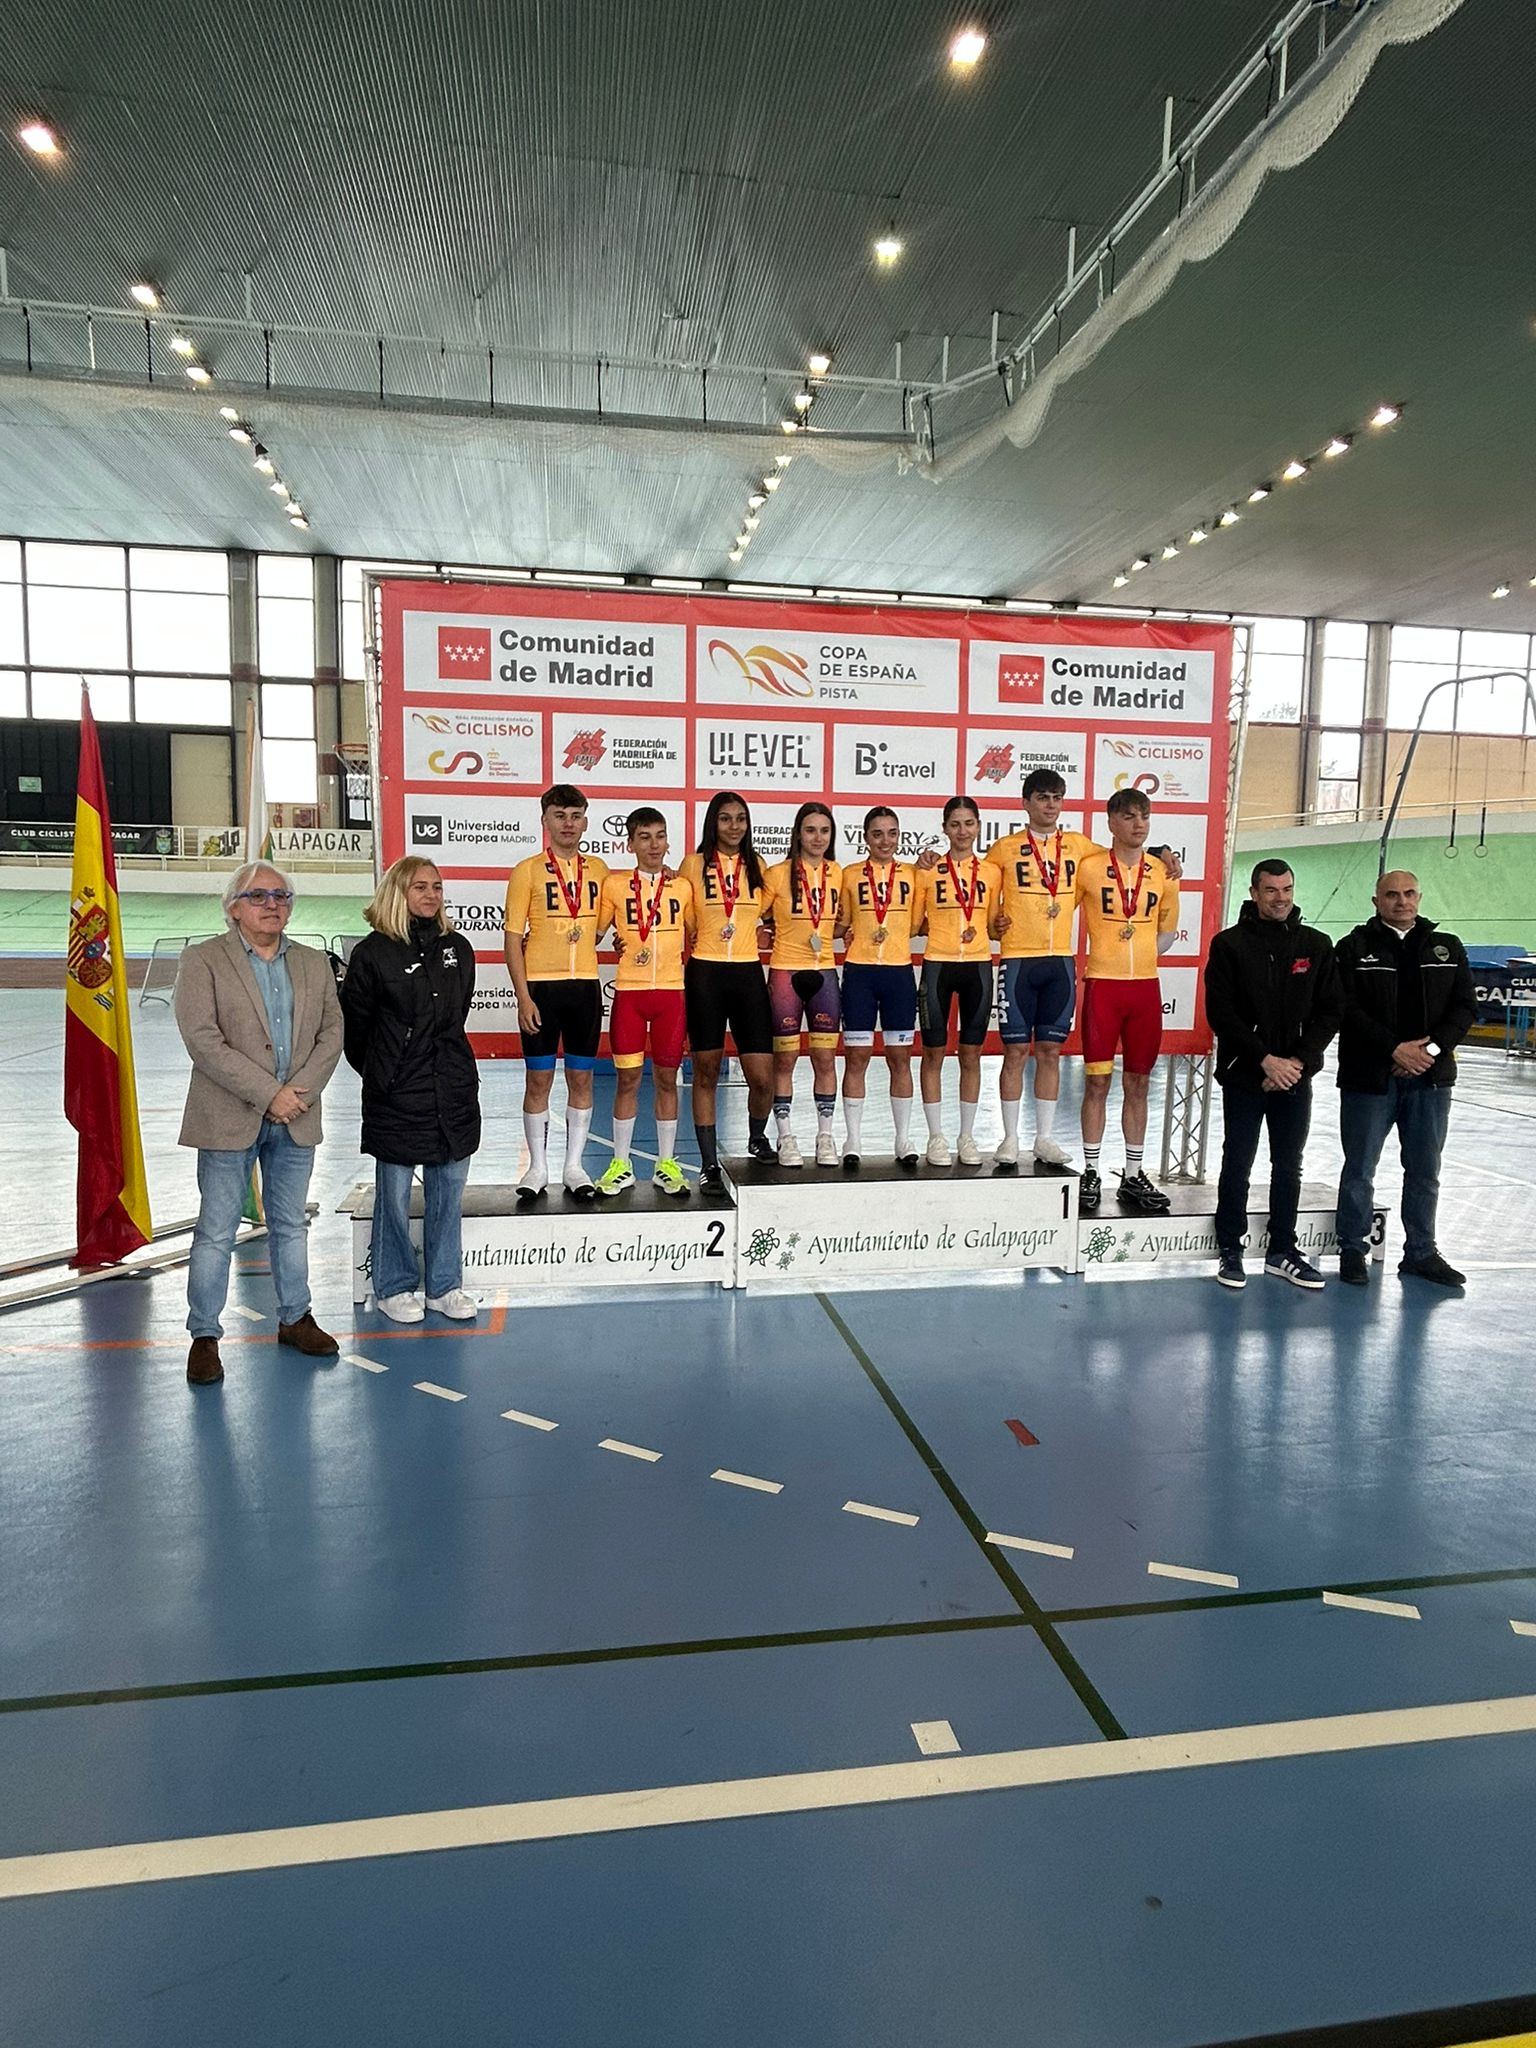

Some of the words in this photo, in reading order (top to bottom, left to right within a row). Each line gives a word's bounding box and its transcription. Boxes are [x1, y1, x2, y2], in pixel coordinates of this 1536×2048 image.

[499, 629, 654, 657] Comunidad
[820, 645, 868, 660] COPA
[499, 659, 537, 683] de
[549, 661, 653, 688] Madrid
[820, 663, 842, 676] DE
[849, 663, 917, 680] ESPAÑA
[1052, 657, 1187, 681] Comunidad
[820, 687, 858, 699] PISTA
[1051, 684, 1083, 706] de
[1093, 686, 1185, 710] Madrid
[456, 722, 534, 737] CICLISMO
[613, 738, 667, 749] FEDERACIÓN
[613, 749, 664, 760] MADRILEÑA
[666, 751, 677, 760] DE
[1020, 752, 1069, 762] FEDERACIÓN
[1138, 747, 1204, 760] CICLISMO
[613, 760, 654, 769] CICLISMO
[882, 761, 935, 778] travel
[709, 769, 810, 778] SPORTWEAR
[416, 824, 439, 837] ue
[448, 820, 520, 831] Universidad
[753, 826, 792, 834] FEDERAC
[38, 830, 75, 838] CICLIST
[448, 832, 498, 844] Europea
[501, 835, 537, 843] MADRID
[753, 837, 790, 845] MADRILE
[1511, 978, 1536, 987] CLU
[1061, 1185, 1069, 1219] 1
[1370, 1213, 1385, 1246] 3
[706, 1220, 725, 1257] 2
[807, 1229, 929, 1264] Ayuntamiento
[936, 1224, 956, 1249] de
[964, 1222, 1058, 1257] Galapagar
[462, 1242, 566, 1268] untamiento
[575, 1236, 597, 1264] de
[606, 1235, 709, 1271] Galapagar
